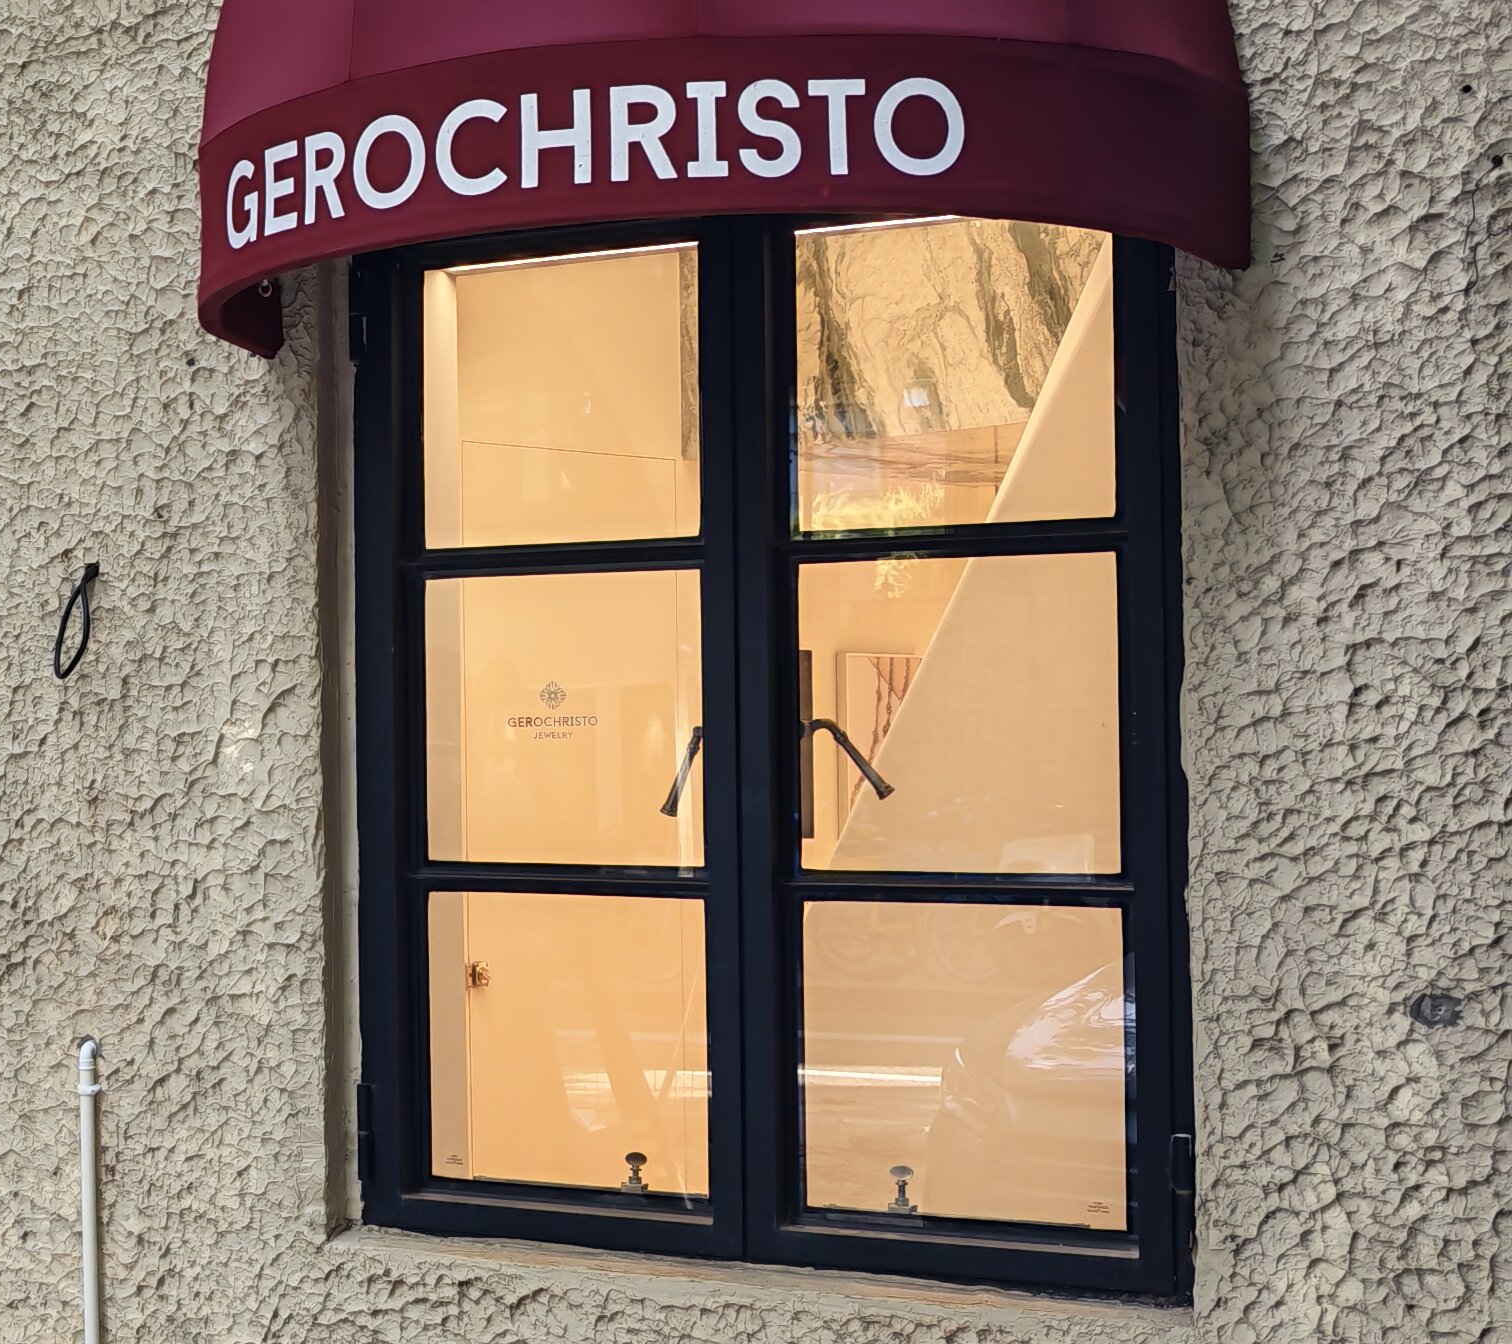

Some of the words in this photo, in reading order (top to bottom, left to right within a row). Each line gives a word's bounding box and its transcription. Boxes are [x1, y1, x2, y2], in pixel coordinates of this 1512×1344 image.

[225, 76, 966, 251] GEROCHRISTO
[507, 716, 598, 727] GEROCHRISTO
[533, 731, 573, 739] JEWELRY
